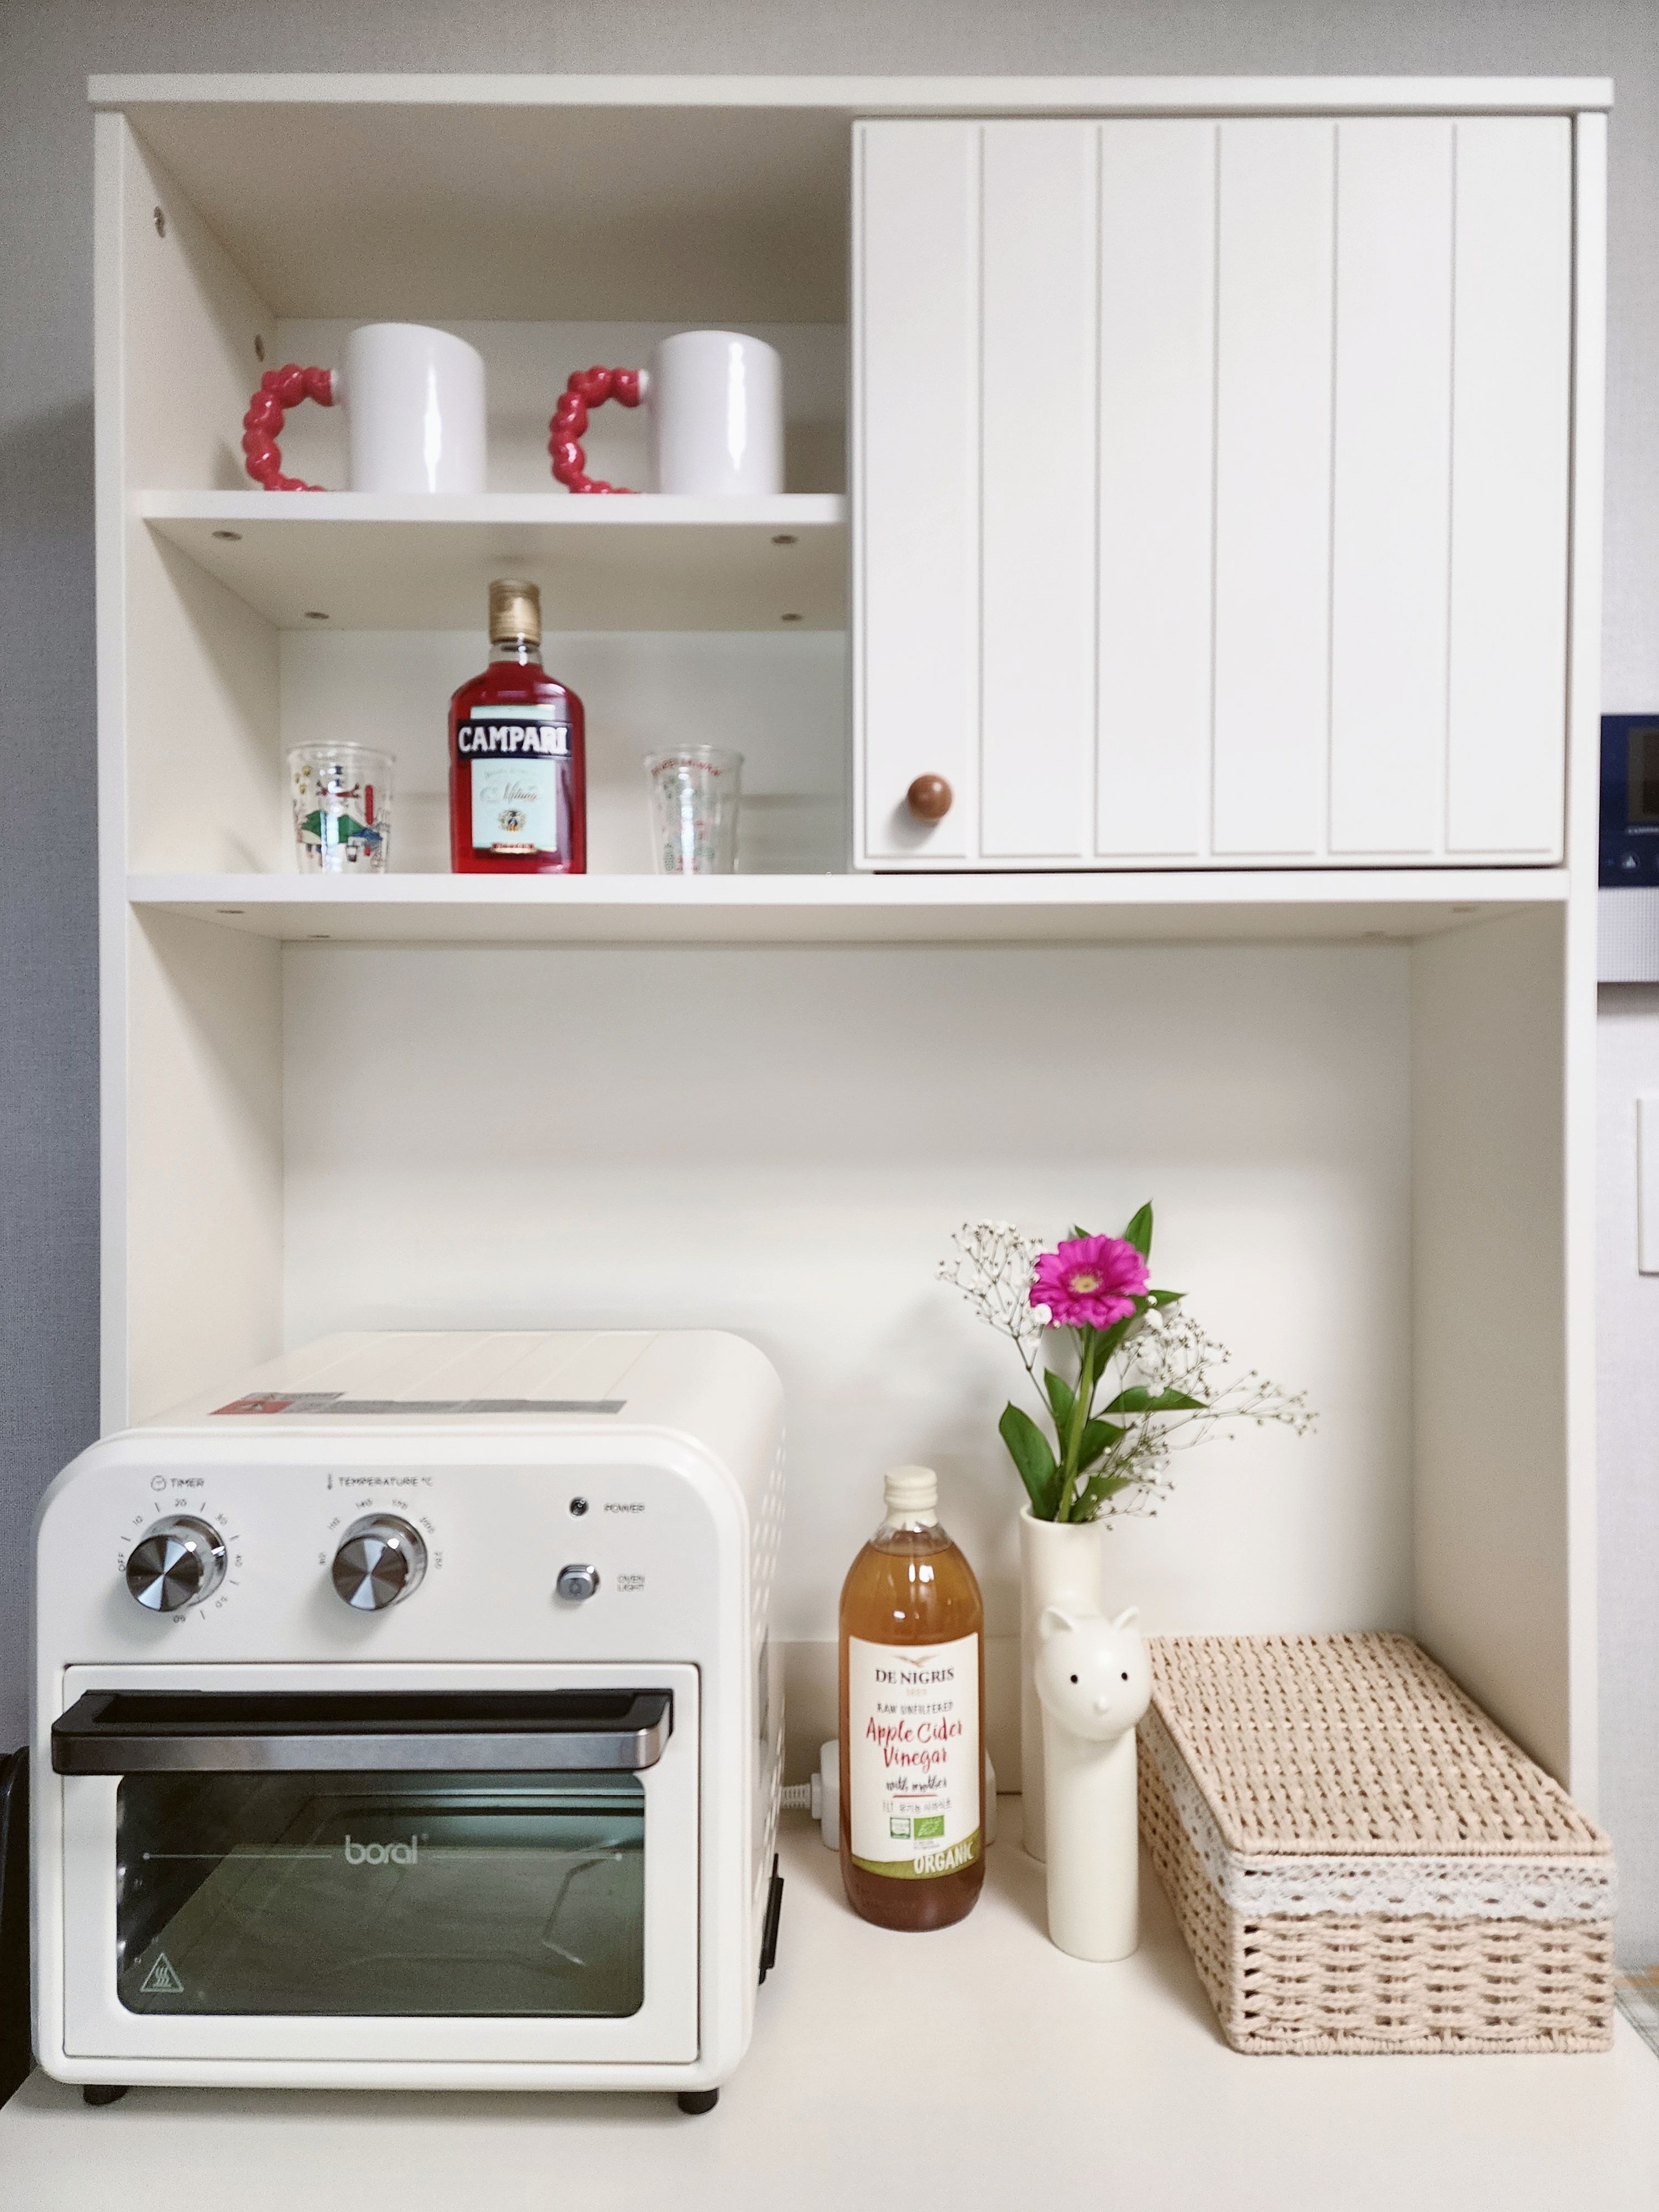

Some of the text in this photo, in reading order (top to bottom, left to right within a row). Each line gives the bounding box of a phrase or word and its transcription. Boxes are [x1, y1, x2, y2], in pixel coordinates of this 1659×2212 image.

[458, 726, 568, 755] CAMPARI
[170, 1478, 205, 1488] TIMER
[338, 1477, 419, 1487] TEMPERATURE
[604, 1503, 645, 1513] POWER
[876, 1668, 955, 1685] DE NIGRIS
[877, 1699, 954, 1715] RAW UNFILTERED
[866, 1716, 963, 1746] Apple Cider
[883, 1746, 947, 1774] Vinegar
[886, 1775, 908, 1791] with
[345, 1835, 418, 1865] boral
[913, 1841, 974, 1874] ORGANIC
